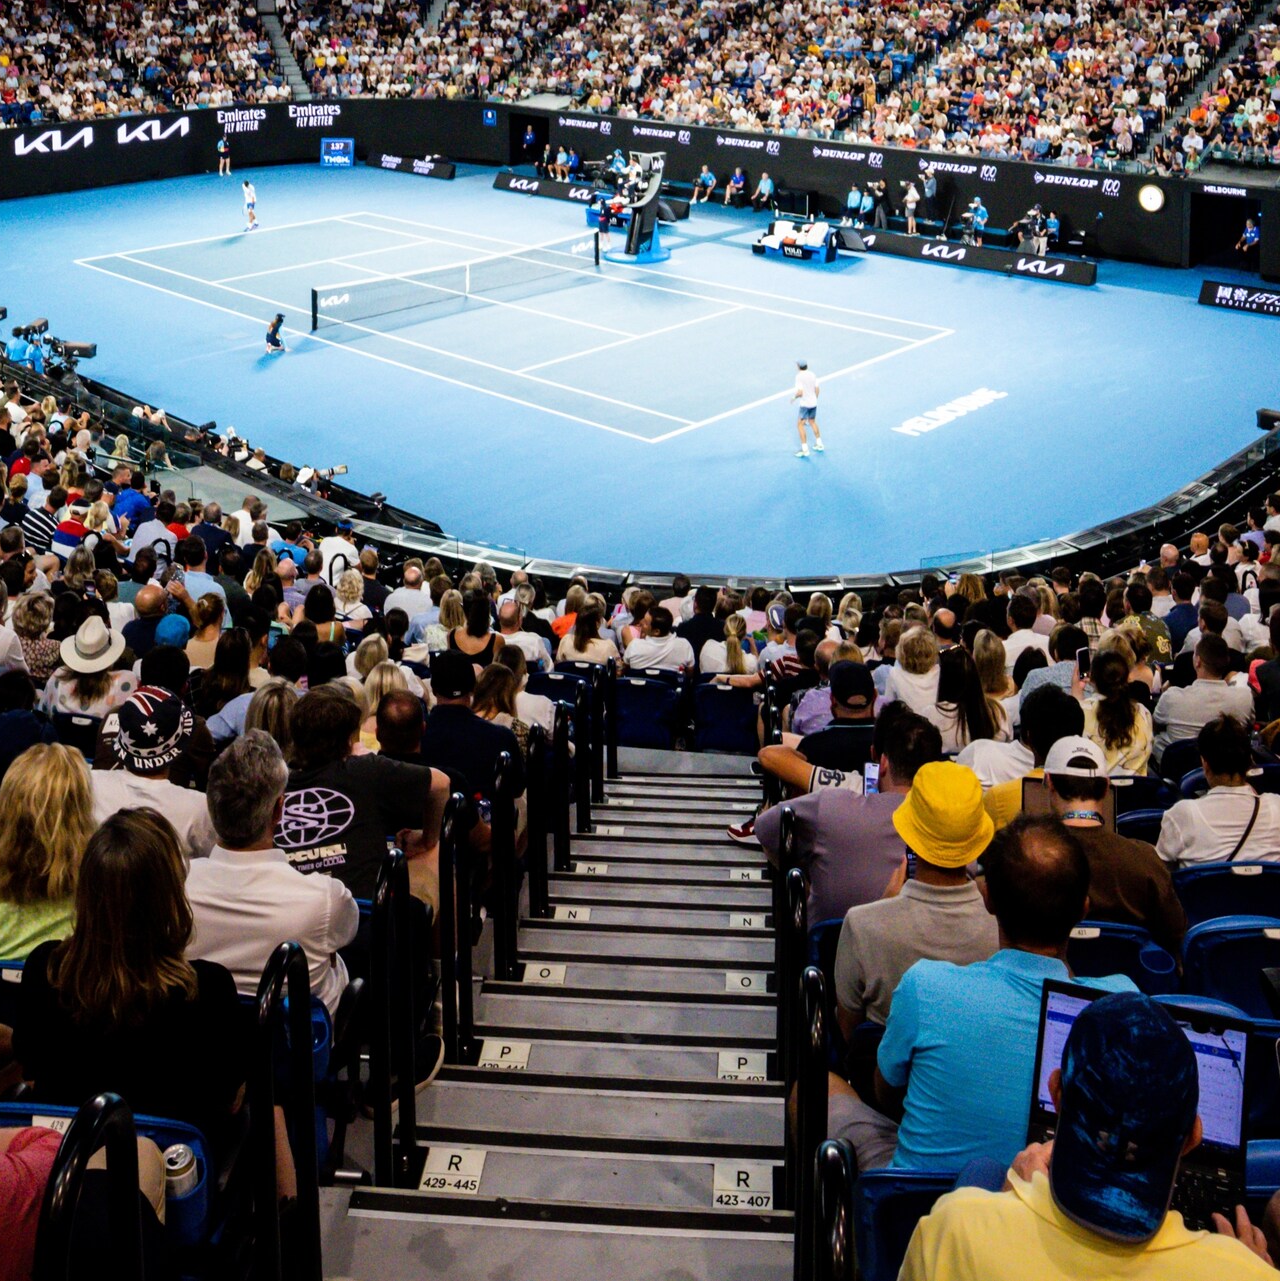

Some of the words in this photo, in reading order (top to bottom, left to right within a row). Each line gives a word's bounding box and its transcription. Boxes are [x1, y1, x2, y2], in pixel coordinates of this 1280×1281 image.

[217, 108, 266, 122] Emirates
[289, 104, 341, 118] Emirates
[224, 122, 236, 133] FLY
[237, 121, 258, 132] BETTER
[296, 116, 309, 128] FLY
[310, 115, 333, 127] BETTER
[565, 118, 598, 129] DUNLOP
[117, 117, 189, 144] KIA
[640, 127, 676, 138] DUNLOP
[15, 127, 93, 156] KIA
[331, 142, 344, 150] 137
[724, 137, 764, 149] DUNLOP
[821, 149, 865, 161] DUNLOP
[928, 161, 977, 174] DUNLOP
[509, 178, 539, 191] KIA
[1044, 175, 1098, 188] DUNLOP
[1204, 185, 1247, 196] MELBOURNE
[922, 243, 966, 261] KIA
[1017, 257, 1065, 277] KIA
[133, 747, 182, 768] UNDER
[297, 863, 314, 871] TIMES
[742, 872, 750, 880] M
[568, 911, 577, 919] N
[743, 918, 751, 926] N
[540, 968, 550, 978] O
[741, 977, 751, 987] O
[500, 1046, 511, 1058] P
[738, 1057, 748, 1069] P
[448, 1155, 462, 1171] R
[737, 1171, 749, 1187] R
